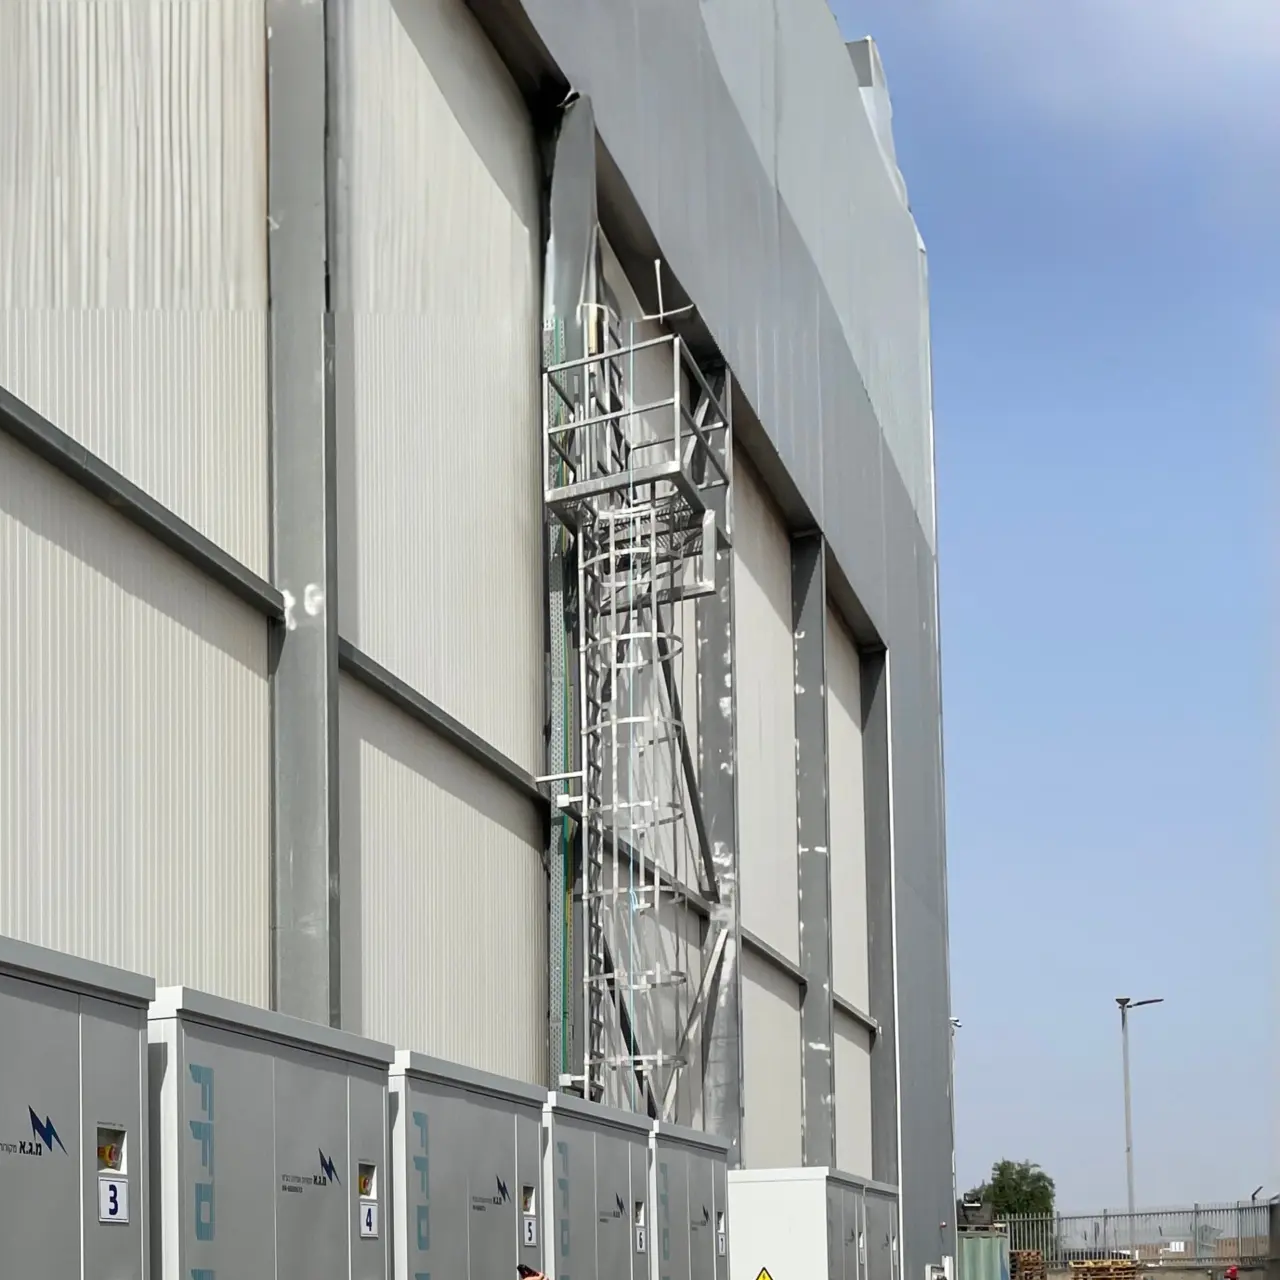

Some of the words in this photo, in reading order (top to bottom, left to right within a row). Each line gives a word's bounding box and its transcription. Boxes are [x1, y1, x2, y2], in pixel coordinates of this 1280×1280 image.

[108, 1184, 119, 1215] 3
[365, 1207, 373, 1231] 4
[527, 1221, 533, 1242] 5
[638, 1231, 643, 1249] 6
